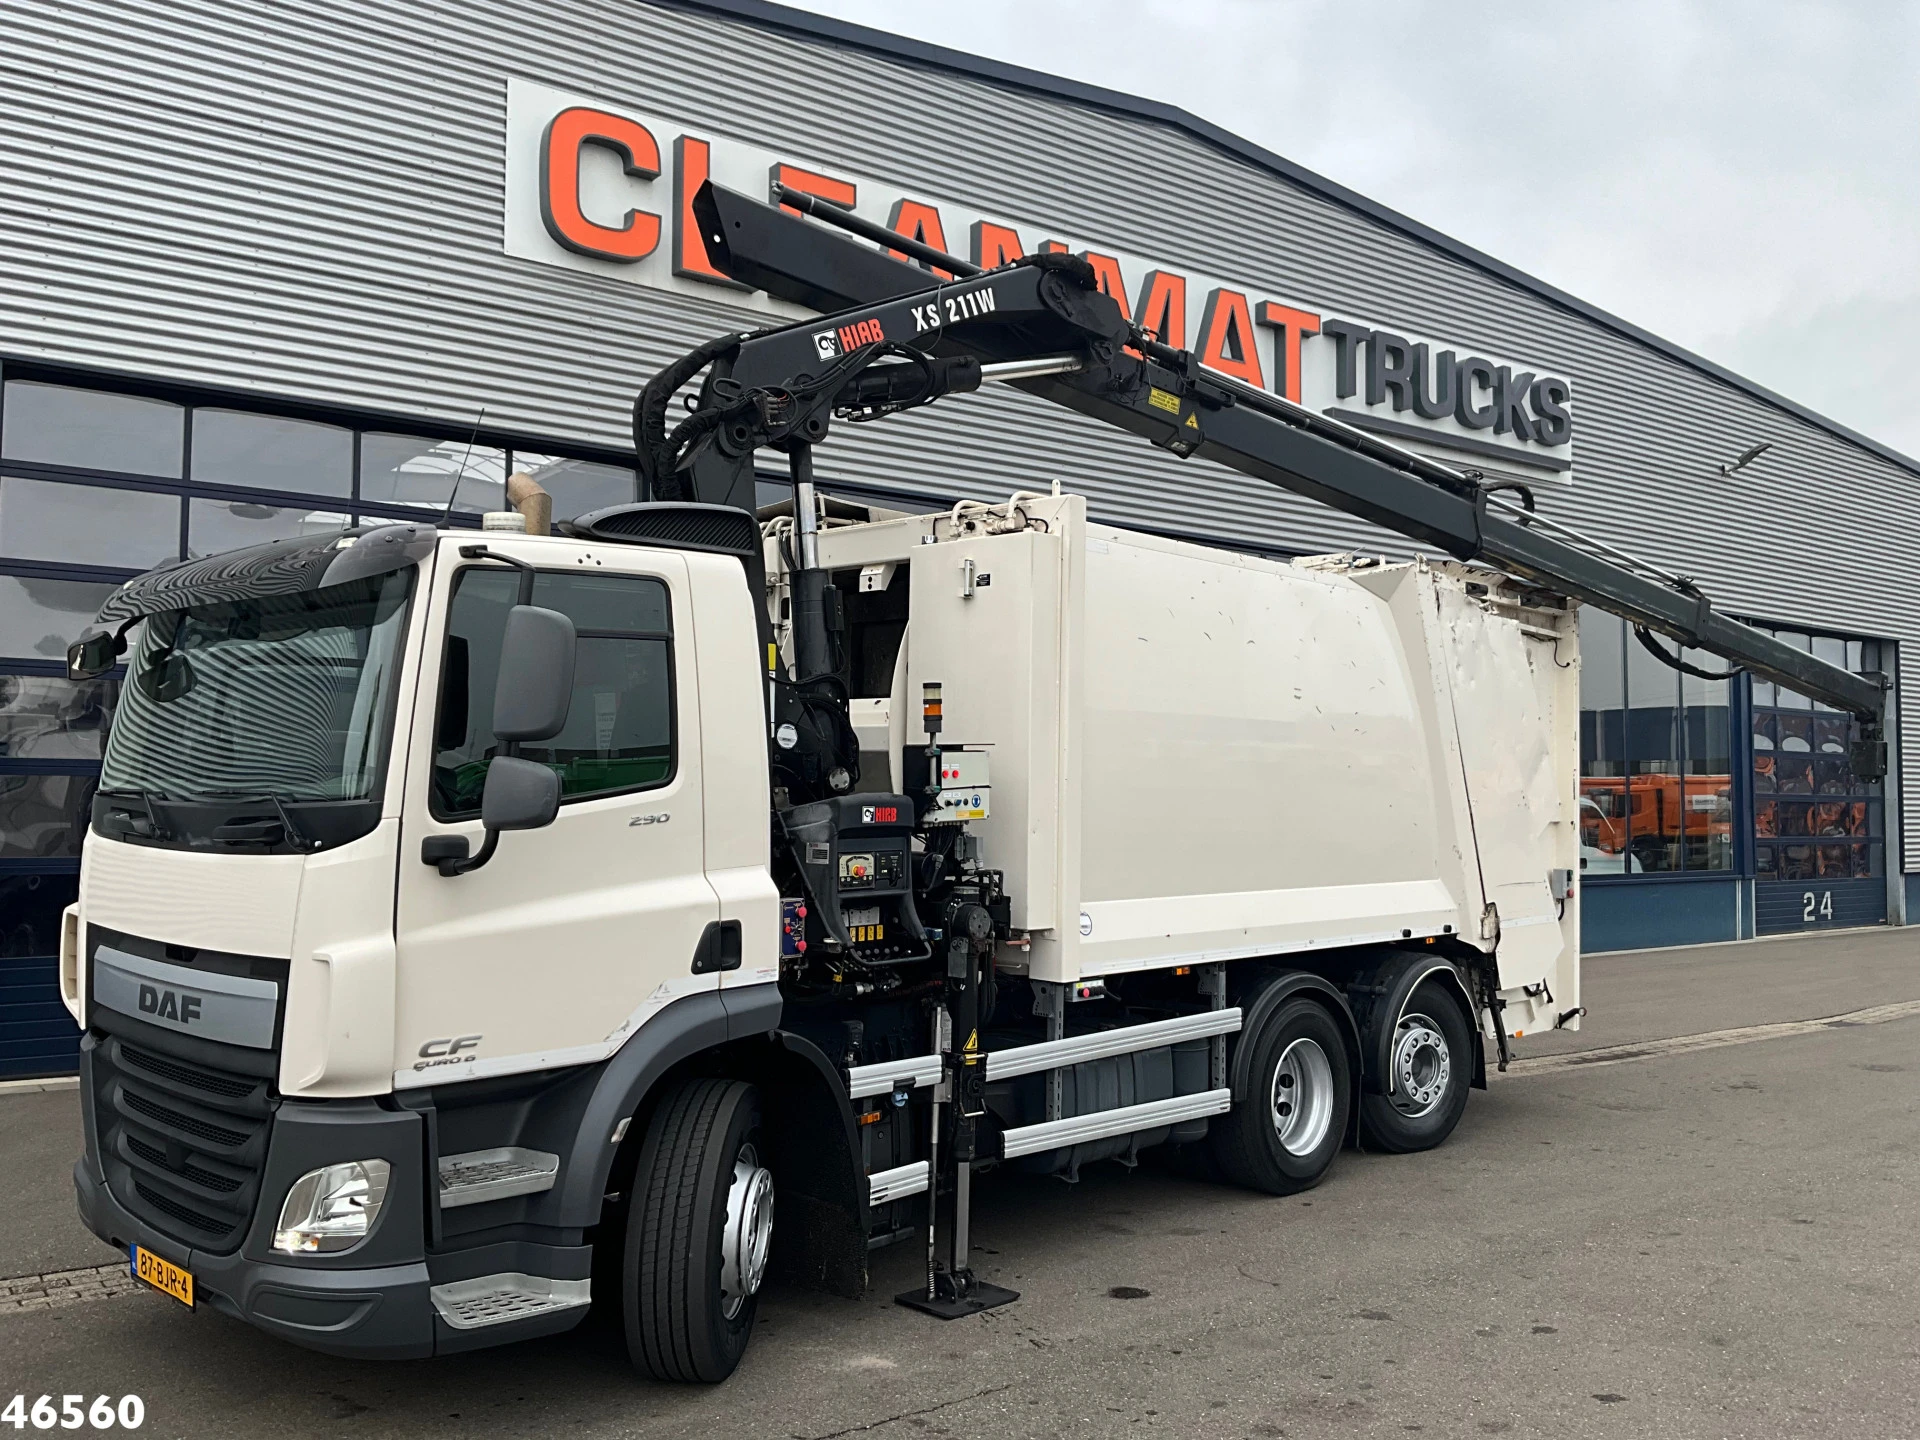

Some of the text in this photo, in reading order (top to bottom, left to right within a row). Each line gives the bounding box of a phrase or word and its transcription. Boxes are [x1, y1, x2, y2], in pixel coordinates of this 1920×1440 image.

[910, 287, 996, 332] XS 211W
[838, 318, 884, 352] HIAB
[1322, 319, 1572, 446] TRUCKS
[629, 813, 671, 827] 290
[875, 807, 897, 822] HIAB
[1803, 891, 1833, 922] 24
[138, 983, 202, 1024] DAF
[418, 1034, 483, 1058] CF
[413, 1056, 461, 1071] EURO
[140, 1252, 188, 1299] 87-BJR-4
